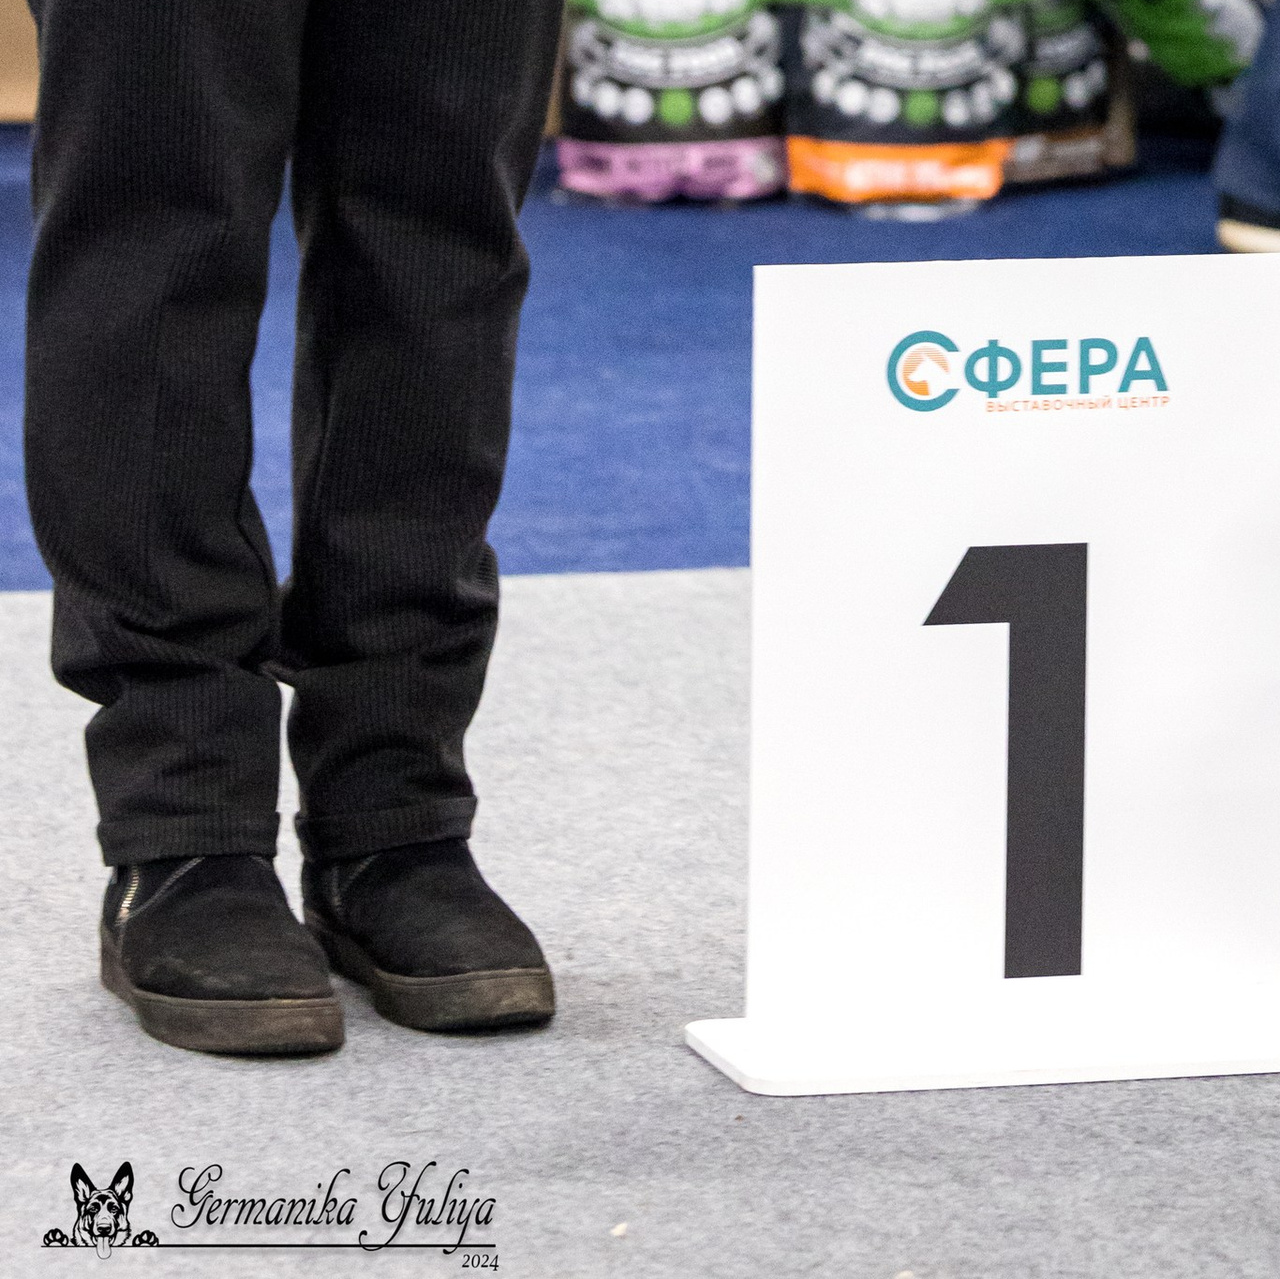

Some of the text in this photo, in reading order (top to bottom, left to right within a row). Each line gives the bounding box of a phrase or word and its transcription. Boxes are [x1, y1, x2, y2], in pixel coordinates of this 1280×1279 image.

[886, 329, 1169, 412] СФЕРА
[985, 395, 1171, 413] ВЫСТАВОЧНЫЙ ЦЕНТР
[922, 542, 1089, 980] 1
